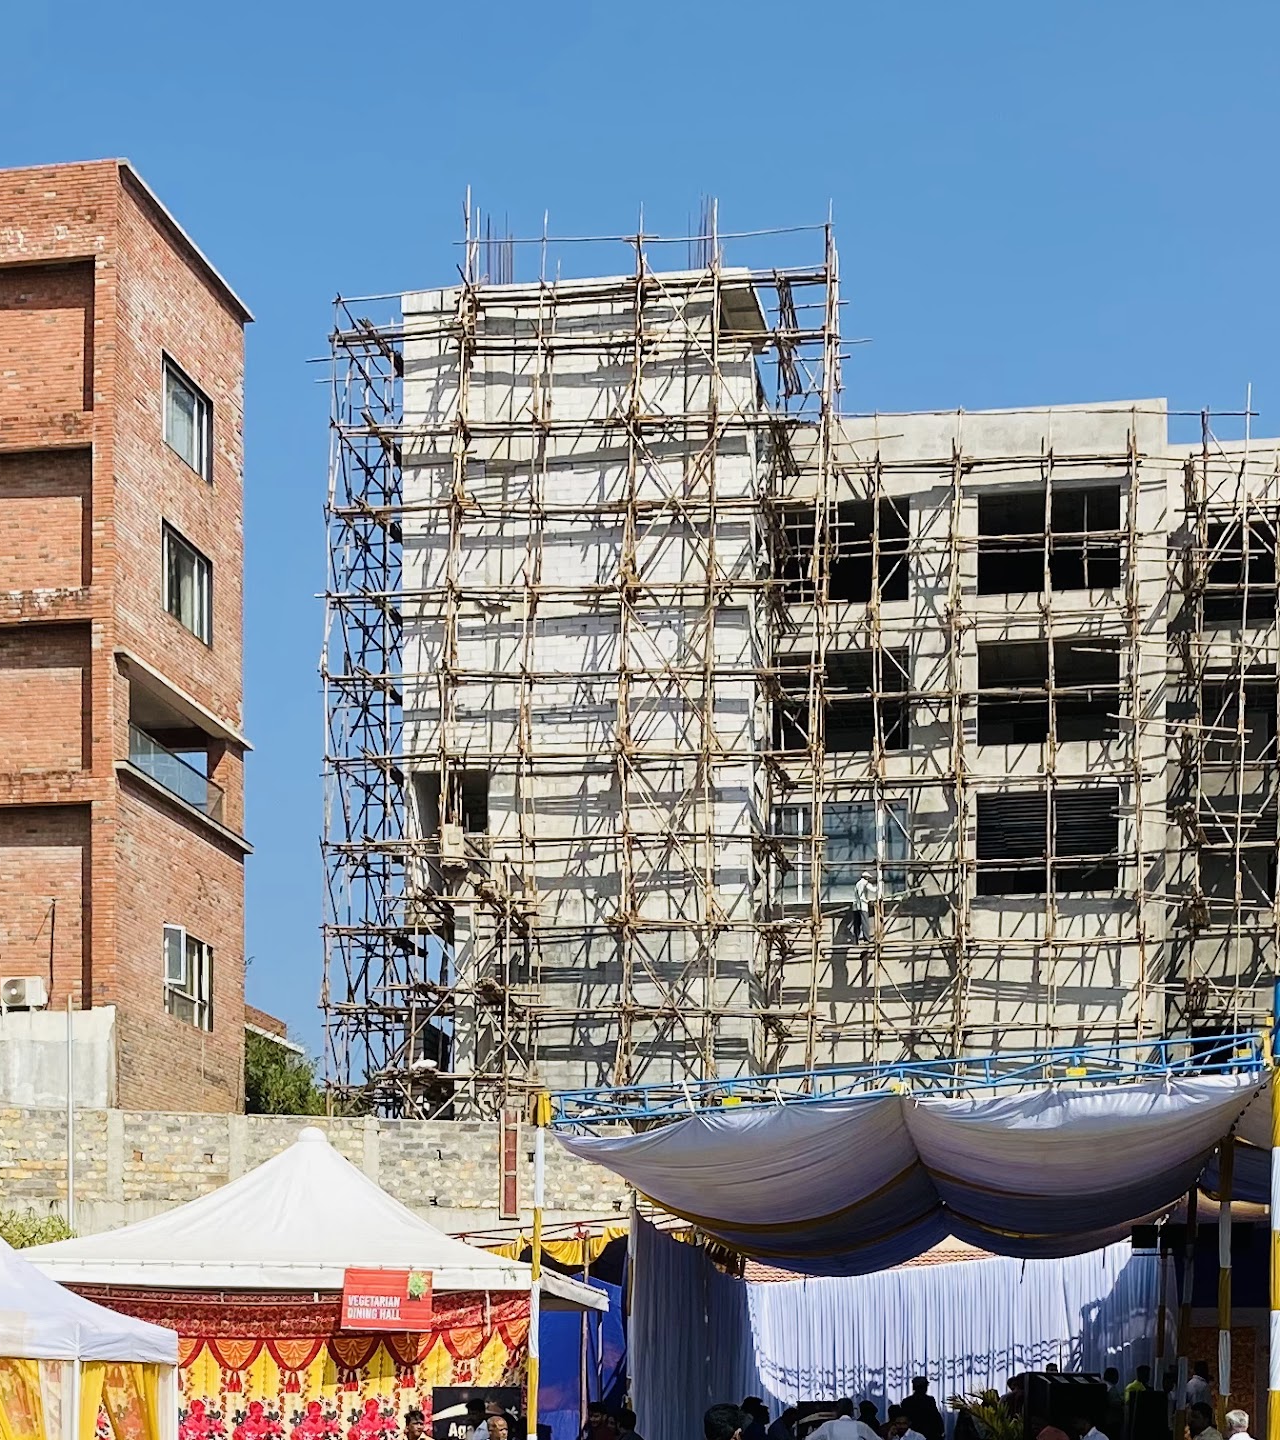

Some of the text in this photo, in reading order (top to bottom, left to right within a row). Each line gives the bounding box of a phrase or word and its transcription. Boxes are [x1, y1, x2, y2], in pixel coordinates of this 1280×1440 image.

[348, 1295, 401, 1307] VEGETARIAN
[348, 1308, 401, 1319] DINING HALL
